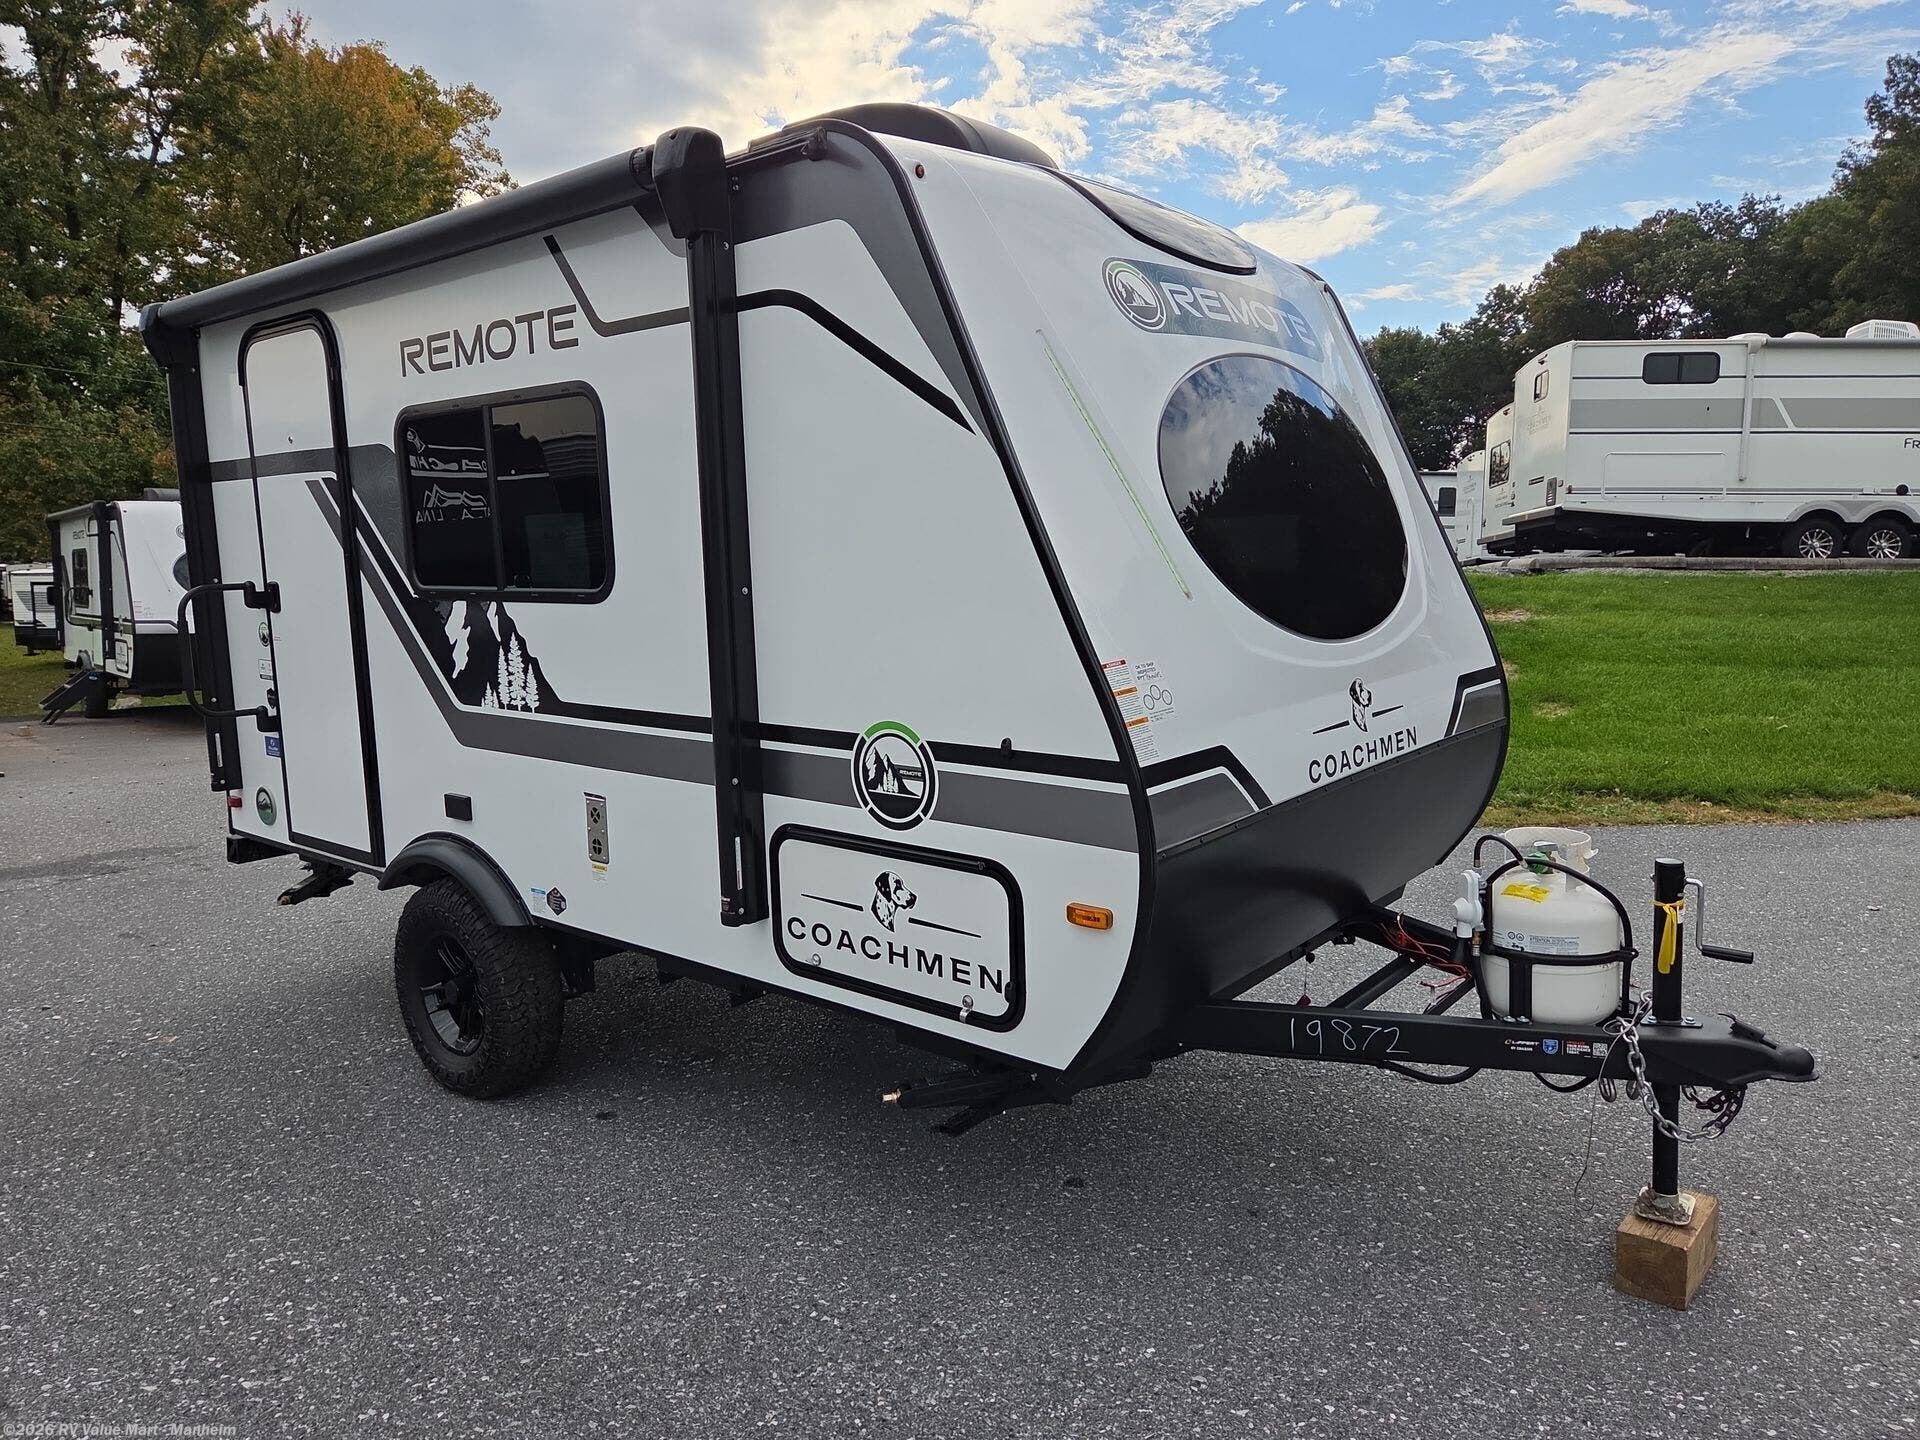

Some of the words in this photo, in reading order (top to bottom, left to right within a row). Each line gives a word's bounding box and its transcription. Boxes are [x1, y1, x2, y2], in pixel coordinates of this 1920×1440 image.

[400, 304, 579, 377] REMOTE
[1159, 281, 1316, 347] REMOTE
[1308, 726, 1417, 784] COACHMEN
[787, 917, 1003, 994] COACHMEN
[1290, 1017, 1410, 1055] 19872
